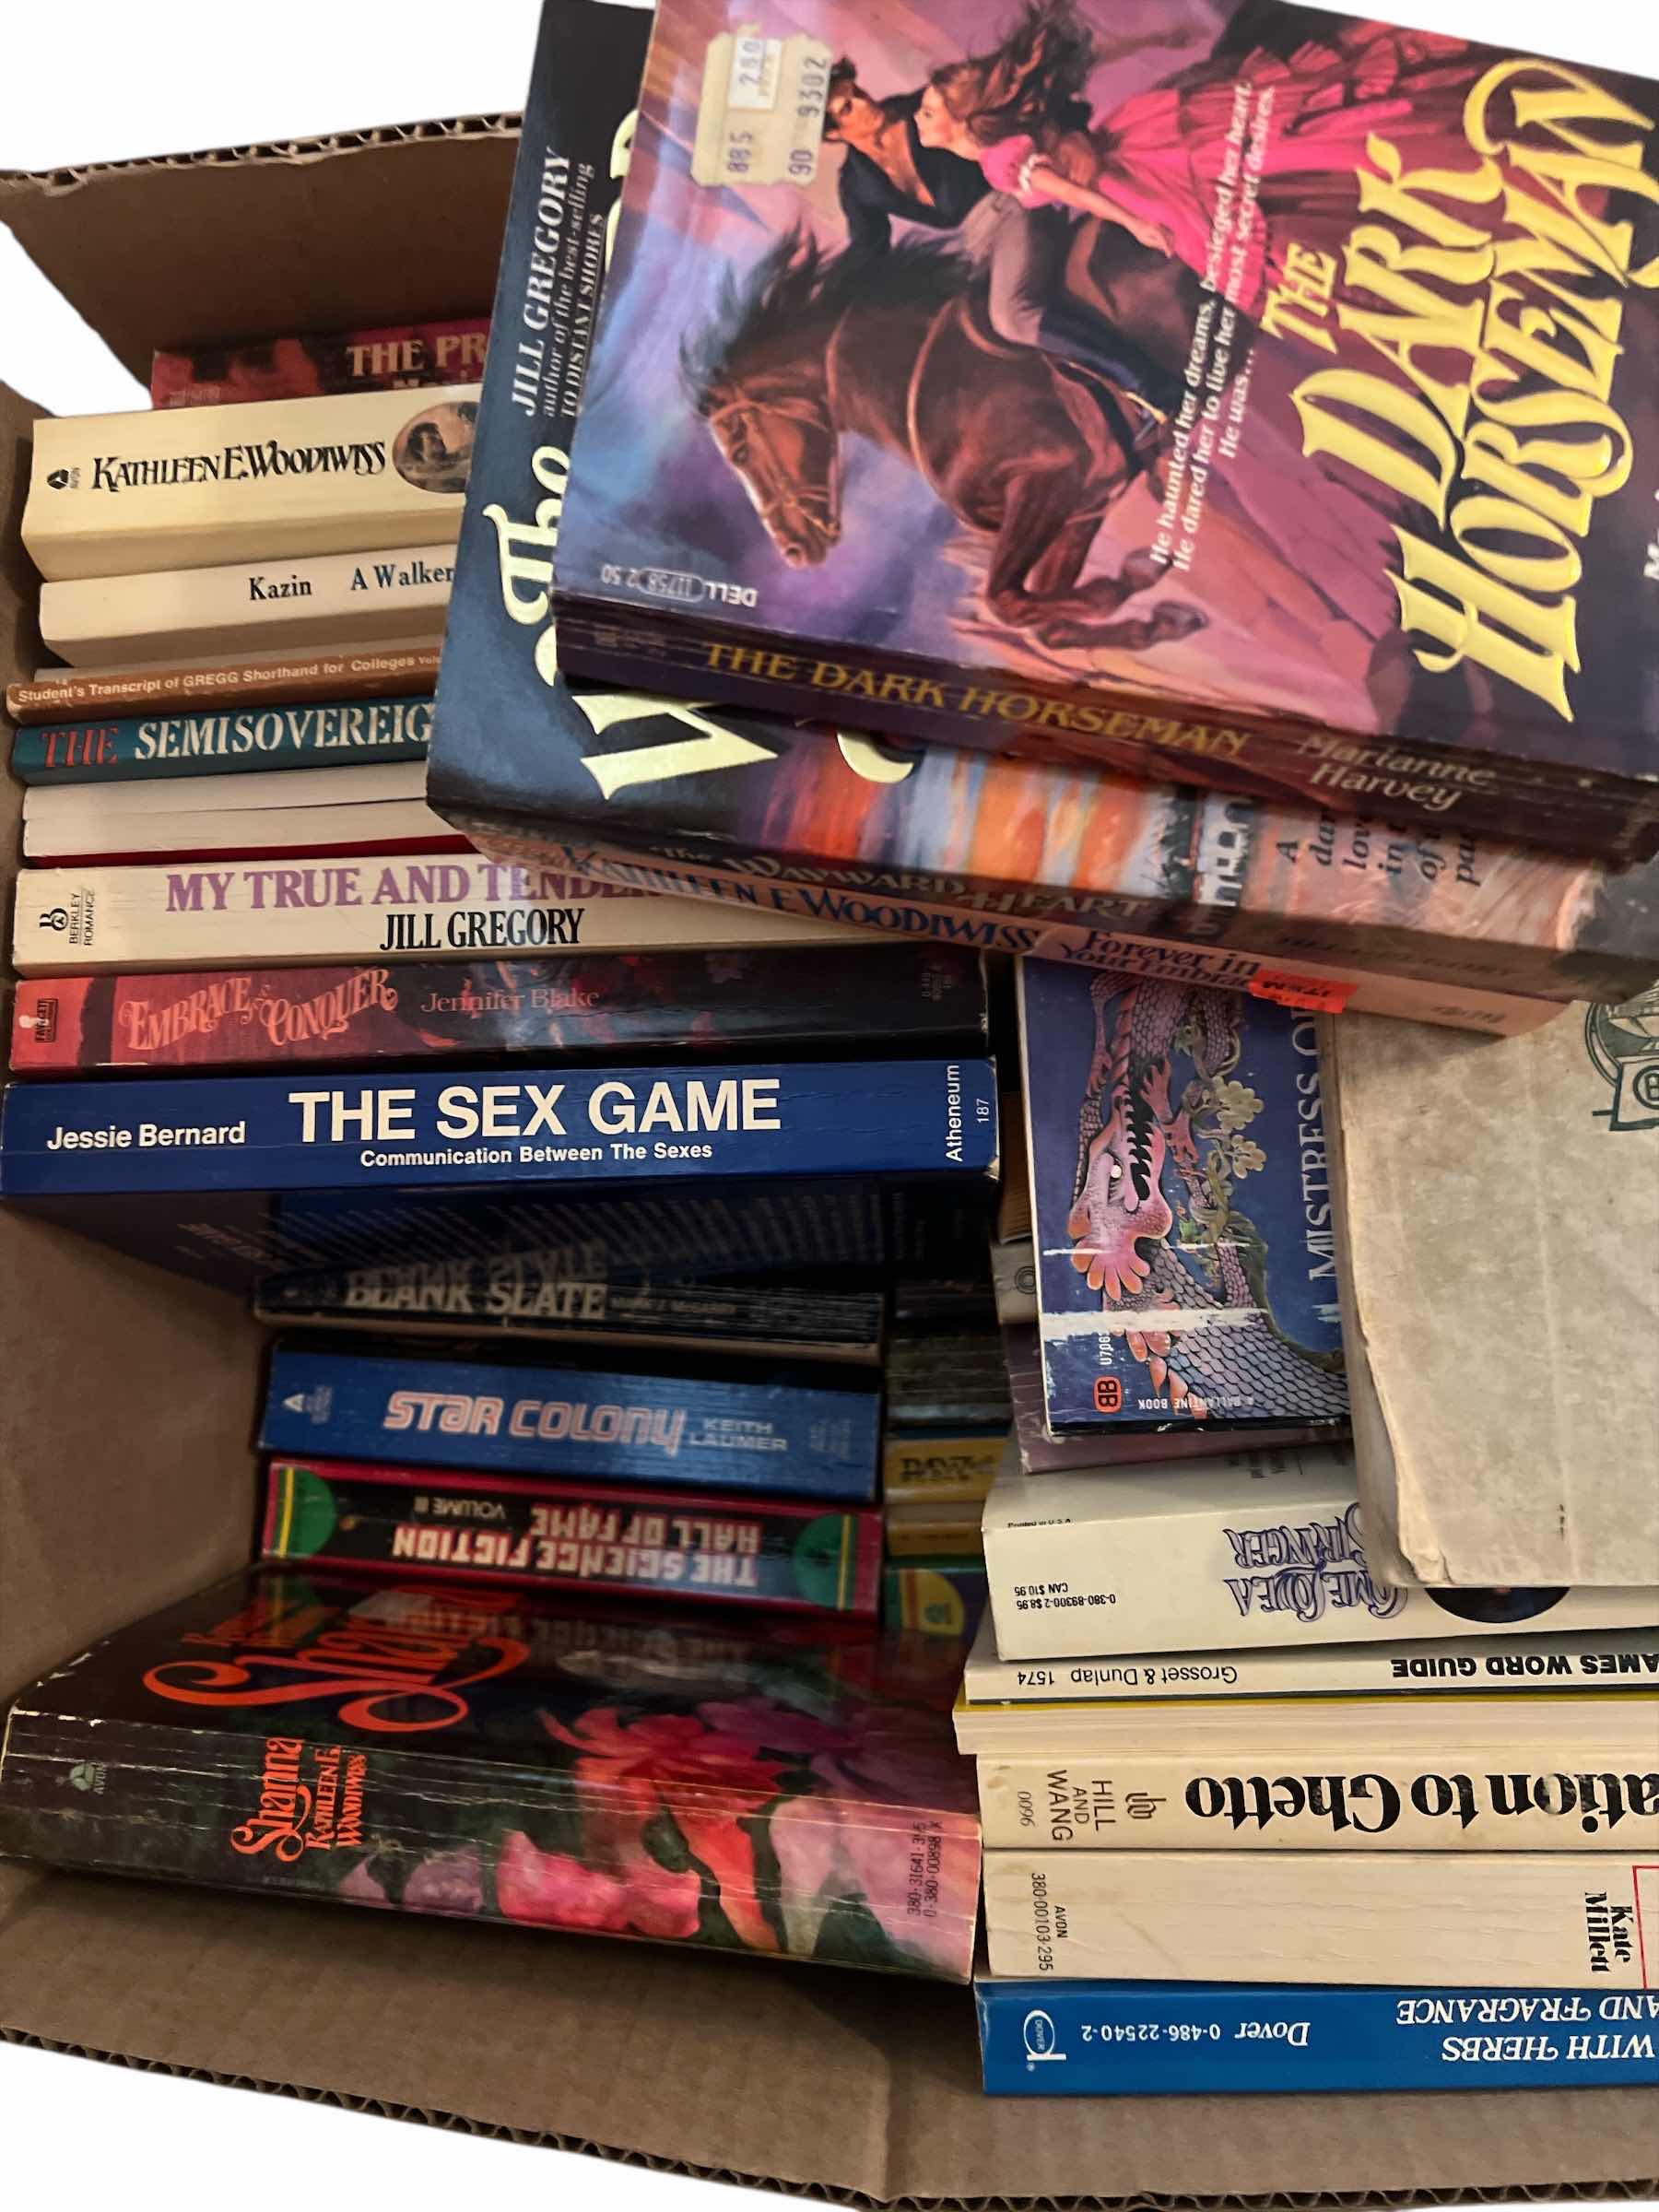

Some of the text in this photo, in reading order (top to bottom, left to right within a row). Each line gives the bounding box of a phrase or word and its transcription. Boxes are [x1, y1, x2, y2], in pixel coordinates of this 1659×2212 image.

[1218, 147, 1241, 185] her
[1236, 174, 1261, 241] secret
[580, 212, 605, 299] SHORES
[1200, 185, 1234, 292] besieged
[512, 145, 571, 418] JILL GREGORY
[1224, 245, 1248, 304] most
[553, 284, 573, 318] the
[1260, 244, 1338, 353] THE
[551, 316, 570, 345] of
[1184, 298, 1218, 388] dreams,
[1214, 305, 1237, 346] her
[1289, 131, 1504, 532] DARK
[346, 340, 425, 377] THE
[1206, 348, 1230, 393] live
[543, 346, 564, 418] author
[1383, 57, 1659, 723] HORSEMAN
[1176, 390, 1197, 429] her
[1202, 396, 1221, 420] to
[1193, 424, 1215, 464] her
[1218, 426, 1240, 458] He
[91, 454, 220, 493] KATHLEEN
[1157, 431, 1189, 529] haunted
[1181, 465, 1208, 534] dared
[1150, 533, 1172, 564] He
[1173, 539, 1195, 571] He
[249, 560, 455, 601] Kazin A Walker
[704, 581, 759, 608] DELL
[18, 685, 85, 703] Student's
[88, 678, 161, 697] Transcript
[164, 677, 180, 689] of
[182, 671, 239, 688] GREGG
[242, 663, 319, 684] Shorthand
[323, 662, 345, 675] for
[349, 655, 415, 672] Colleges
[707, 643, 1250, 758] THE DARK HORSEMAN
[39, 725, 120, 769] THE
[1296, 734, 1499, 787] Marianne
[1311, 761, 1464, 812] Harvey
[1277, 840, 1300, 865] A
[165, 872, 235, 912] MY
[243, 866, 362, 909] TRUE
[368, 863, 471, 905] AND
[69, 892, 81, 945] BERKLEY
[379, 907, 585, 952] JILL GREGORY
[798, 888, 1040, 950] WOODIWISS
[1085, 930, 1209, 966] Forever
[1220, 952, 1262, 976] in
[118, 977, 254, 1051] EMBRACE
[257, 967, 399, 1047] CONQUER
[421, 987, 599, 1013] Jennifer Blake
[288, 1077, 782, 1143] THE SEX GAME
[945, 1064, 964, 1163] Atheneum
[976, 1097, 989, 1124] 187
[46, 1121, 246, 1150] Jessie Bernard
[360, 1141, 712, 1169] Communication Between The Sexes
[1295, 1072, 1338, 1283] MISTRESS
[343, 1284, 475, 1314] BLANK
[486, 1280, 608, 1321] SLATE
[1138, 1397, 1170, 1410] BOOK
[689, 1434, 788, 1453] LAUMER
[704, 1417, 772, 1434] KEITH
[435, 1497, 507, 1521] VOLUME
[530, 1502, 618, 1541] FAME
[621, 1513, 667, 1547] OF
[673, 1520, 762, 1555] HALL
[392, 1524, 759, 1586] THE SCIENCE FICTION
[1015, 1582, 1069, 1596] CAN $10.95
[1017, 1594, 1117, 1610] 0-380-89300-2 $8.95
[1223, 1578, 1253, 1616] A
[1017, 1663, 1238, 1687] Grosset & Dunlap 1574
[1391, 1658, 1477, 1678] GUIDE
[1486, 1655, 1572, 1676] WORD
[93, 1761, 107, 1795] AVON
[230, 1736, 312, 1863] Shanna
[305, 1766, 337, 1851] KATHLEEN
[337, 1754, 368, 1848] WOODIWISS
[1017, 1791, 1036, 1828] 0096
[1047, 1769, 1074, 1841] WANG
[1072, 1786, 1090, 1825] AND
[1092, 1780, 1117, 1831] HILL
[1185, 1773, 1659, 1833] ation to Ghetto
[1053, 1904, 1069, 1939] AVON
[1584, 1891, 1611, 1972] Millett
[1610, 1905, 1635, 1963] Kate
[1396, 1996, 1592, 2026] FRAGRANCE
[1081, 2024, 1221, 2043] 0-486-22540-2
[1235, 2020, 1310, 2048] Dover
[1441, 2034, 1655, 2062] WITH HERBS
